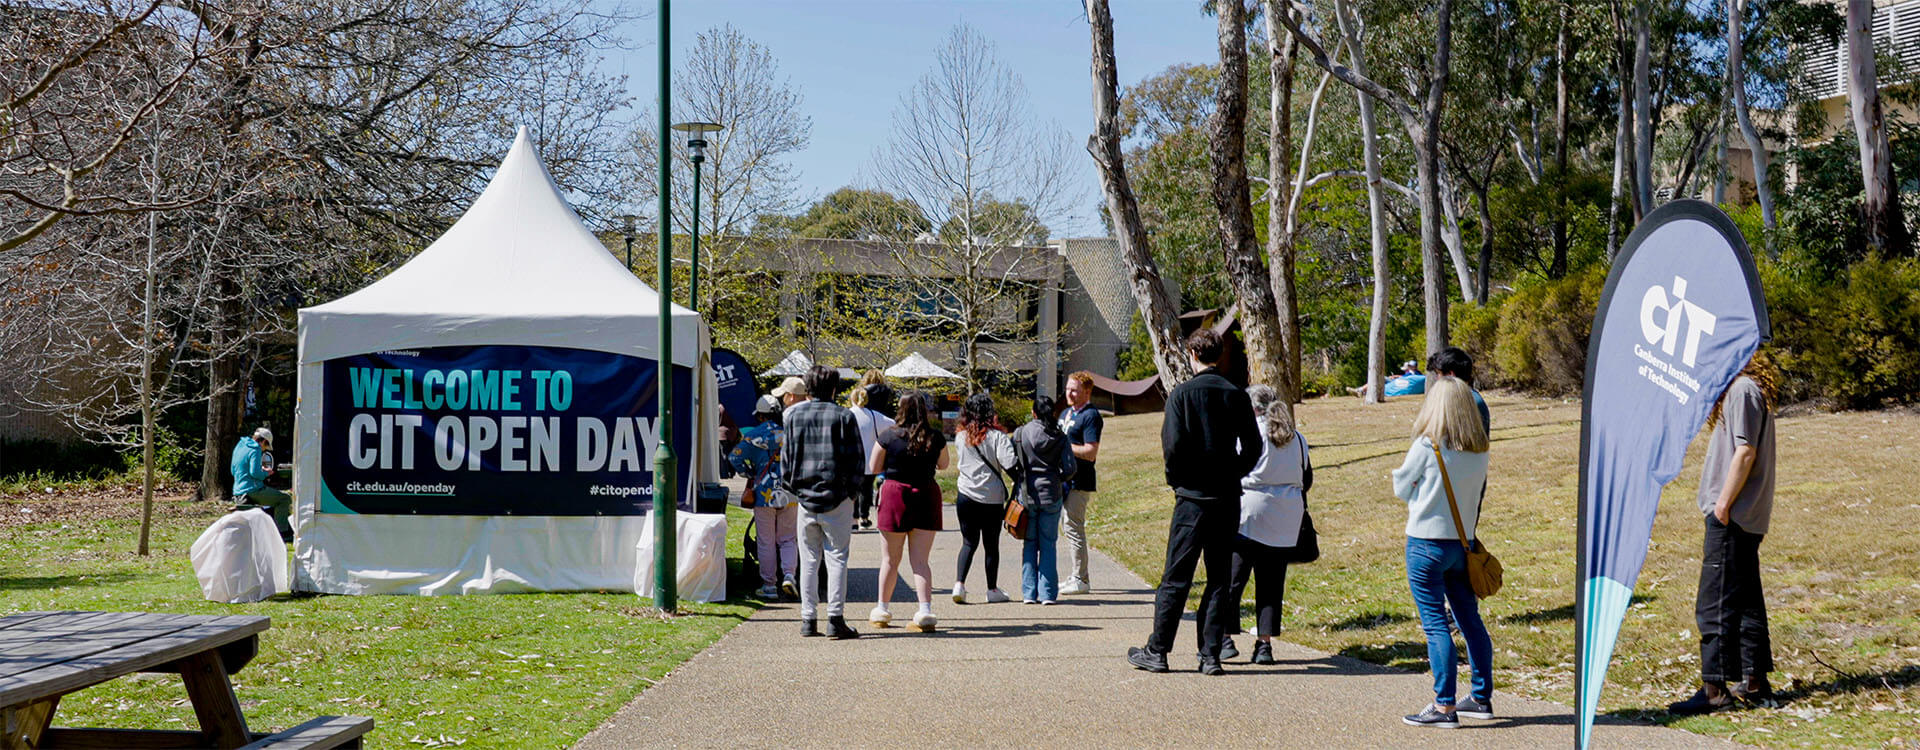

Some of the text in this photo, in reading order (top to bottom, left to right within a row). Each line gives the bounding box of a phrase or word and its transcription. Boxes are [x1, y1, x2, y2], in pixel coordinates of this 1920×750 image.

[349, 367, 573, 411] WELCOME TO
[1634, 344, 1701, 393] Canberra Institute
[1638, 365, 1689, 406] of Technology
[348, 413, 661, 472] CIT OPEN DAY
[346, 481, 456, 495] cit.edu.au/openday
